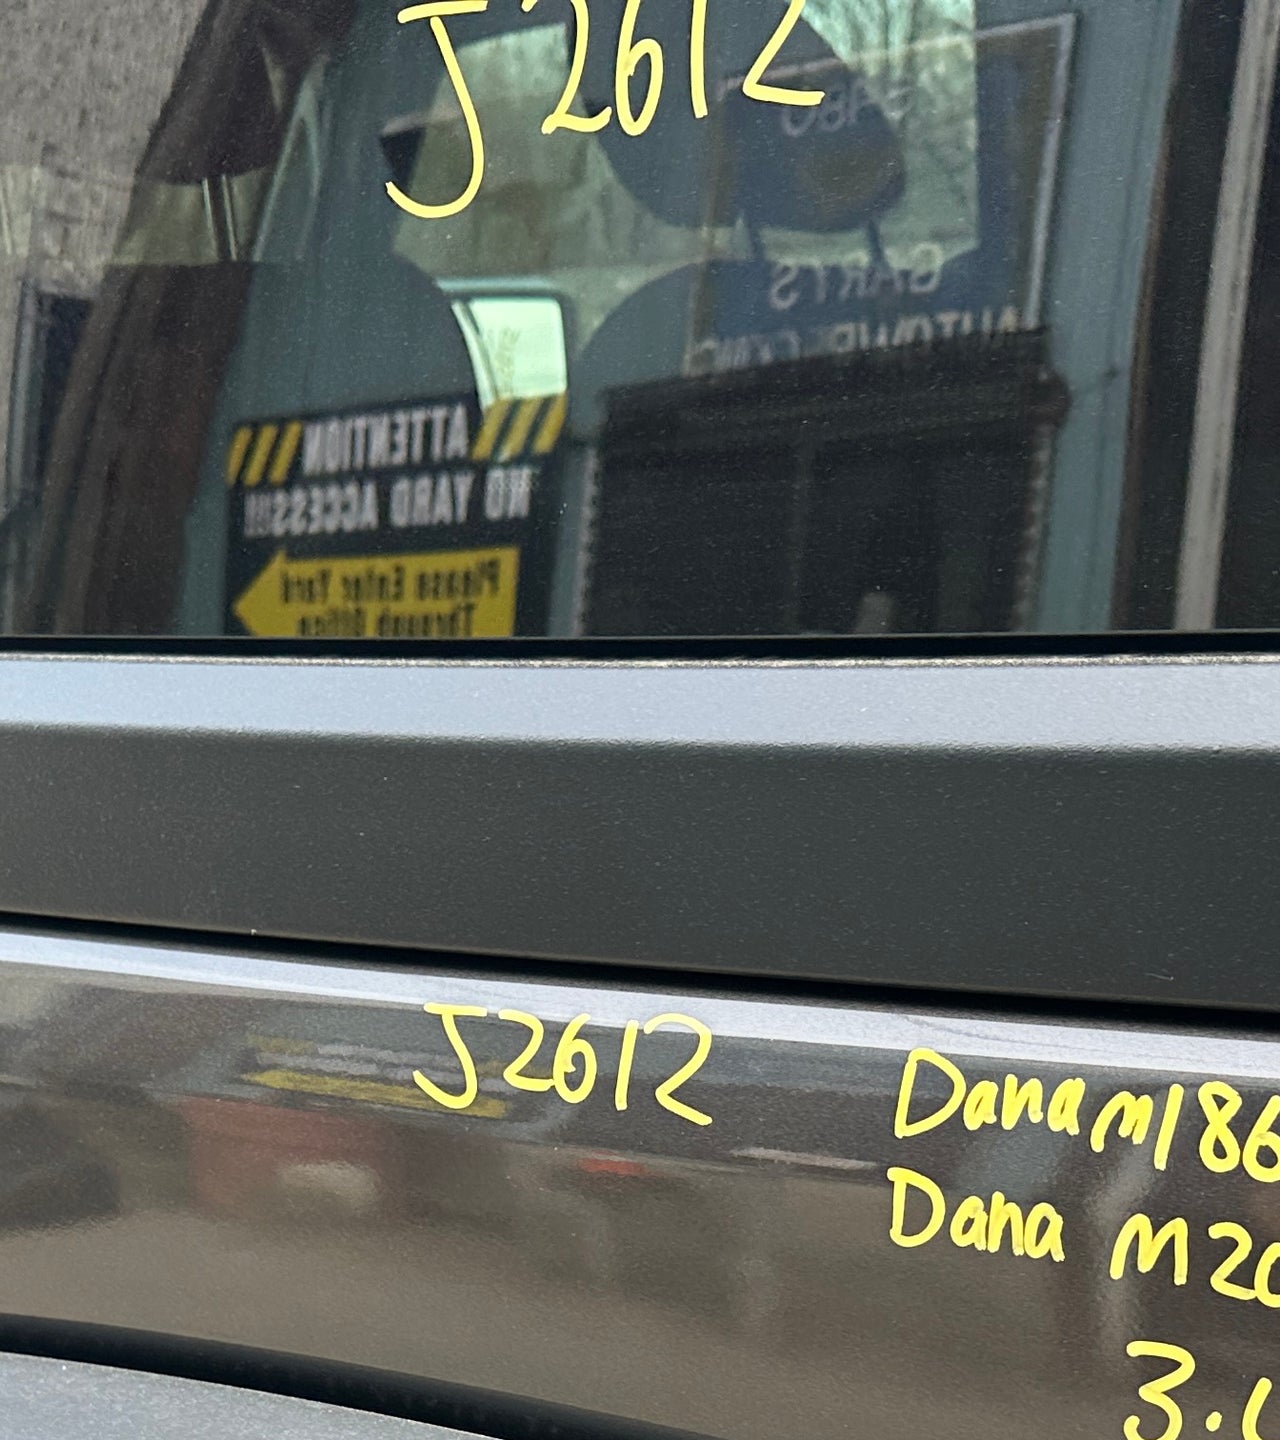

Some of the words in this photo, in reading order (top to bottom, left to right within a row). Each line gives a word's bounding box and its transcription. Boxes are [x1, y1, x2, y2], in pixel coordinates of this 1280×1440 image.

[388, 0, 822, 218] J2612
[414, 1005, 712, 1125] J2612
[887, 1167, 1065, 1261] Dana
